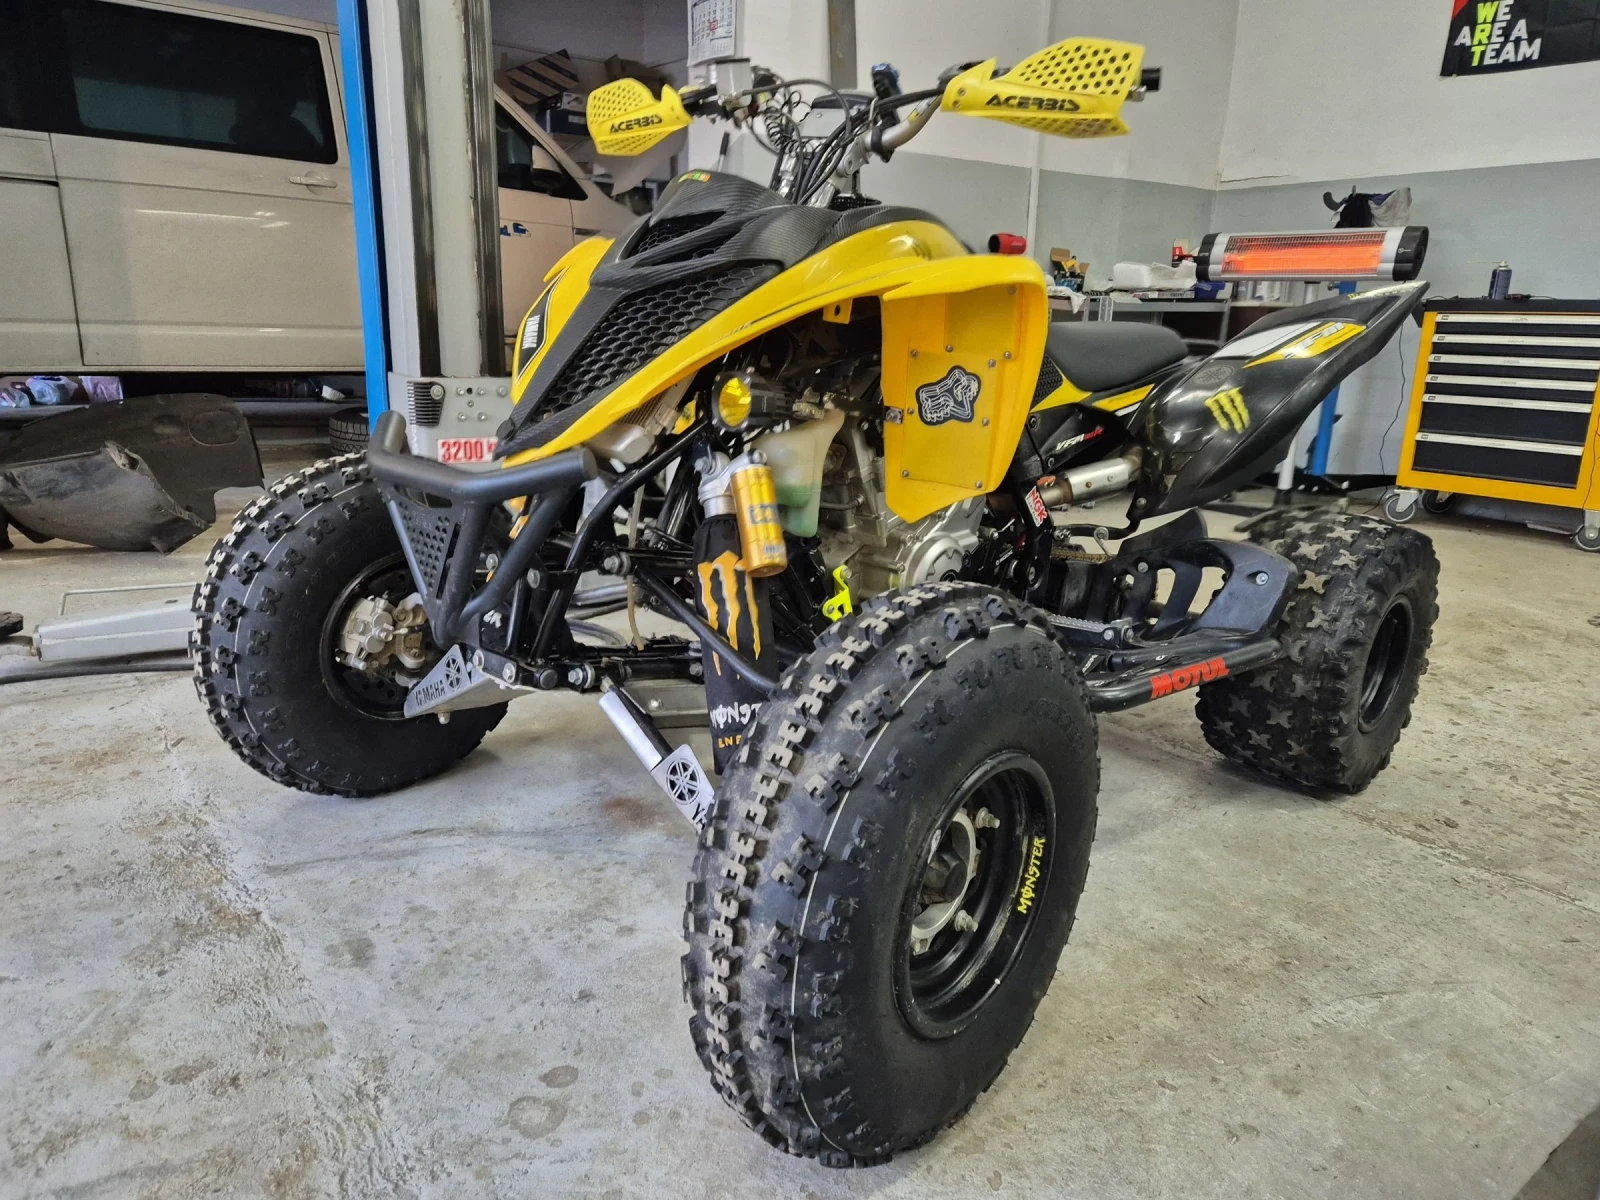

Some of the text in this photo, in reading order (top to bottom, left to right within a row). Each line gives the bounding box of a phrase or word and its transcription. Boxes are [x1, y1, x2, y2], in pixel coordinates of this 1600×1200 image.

[1477, 0, 1514, 23] WE
[1454, 18, 1528, 46] ARE A
[1471, 38, 1542, 67] TEAM
[441, 440, 484, 462] 3200
[1028, 489, 1048, 524] NGK
[1150, 656, 1231, 700] MOTUL
[414, 679, 446, 706] YAMAHA
